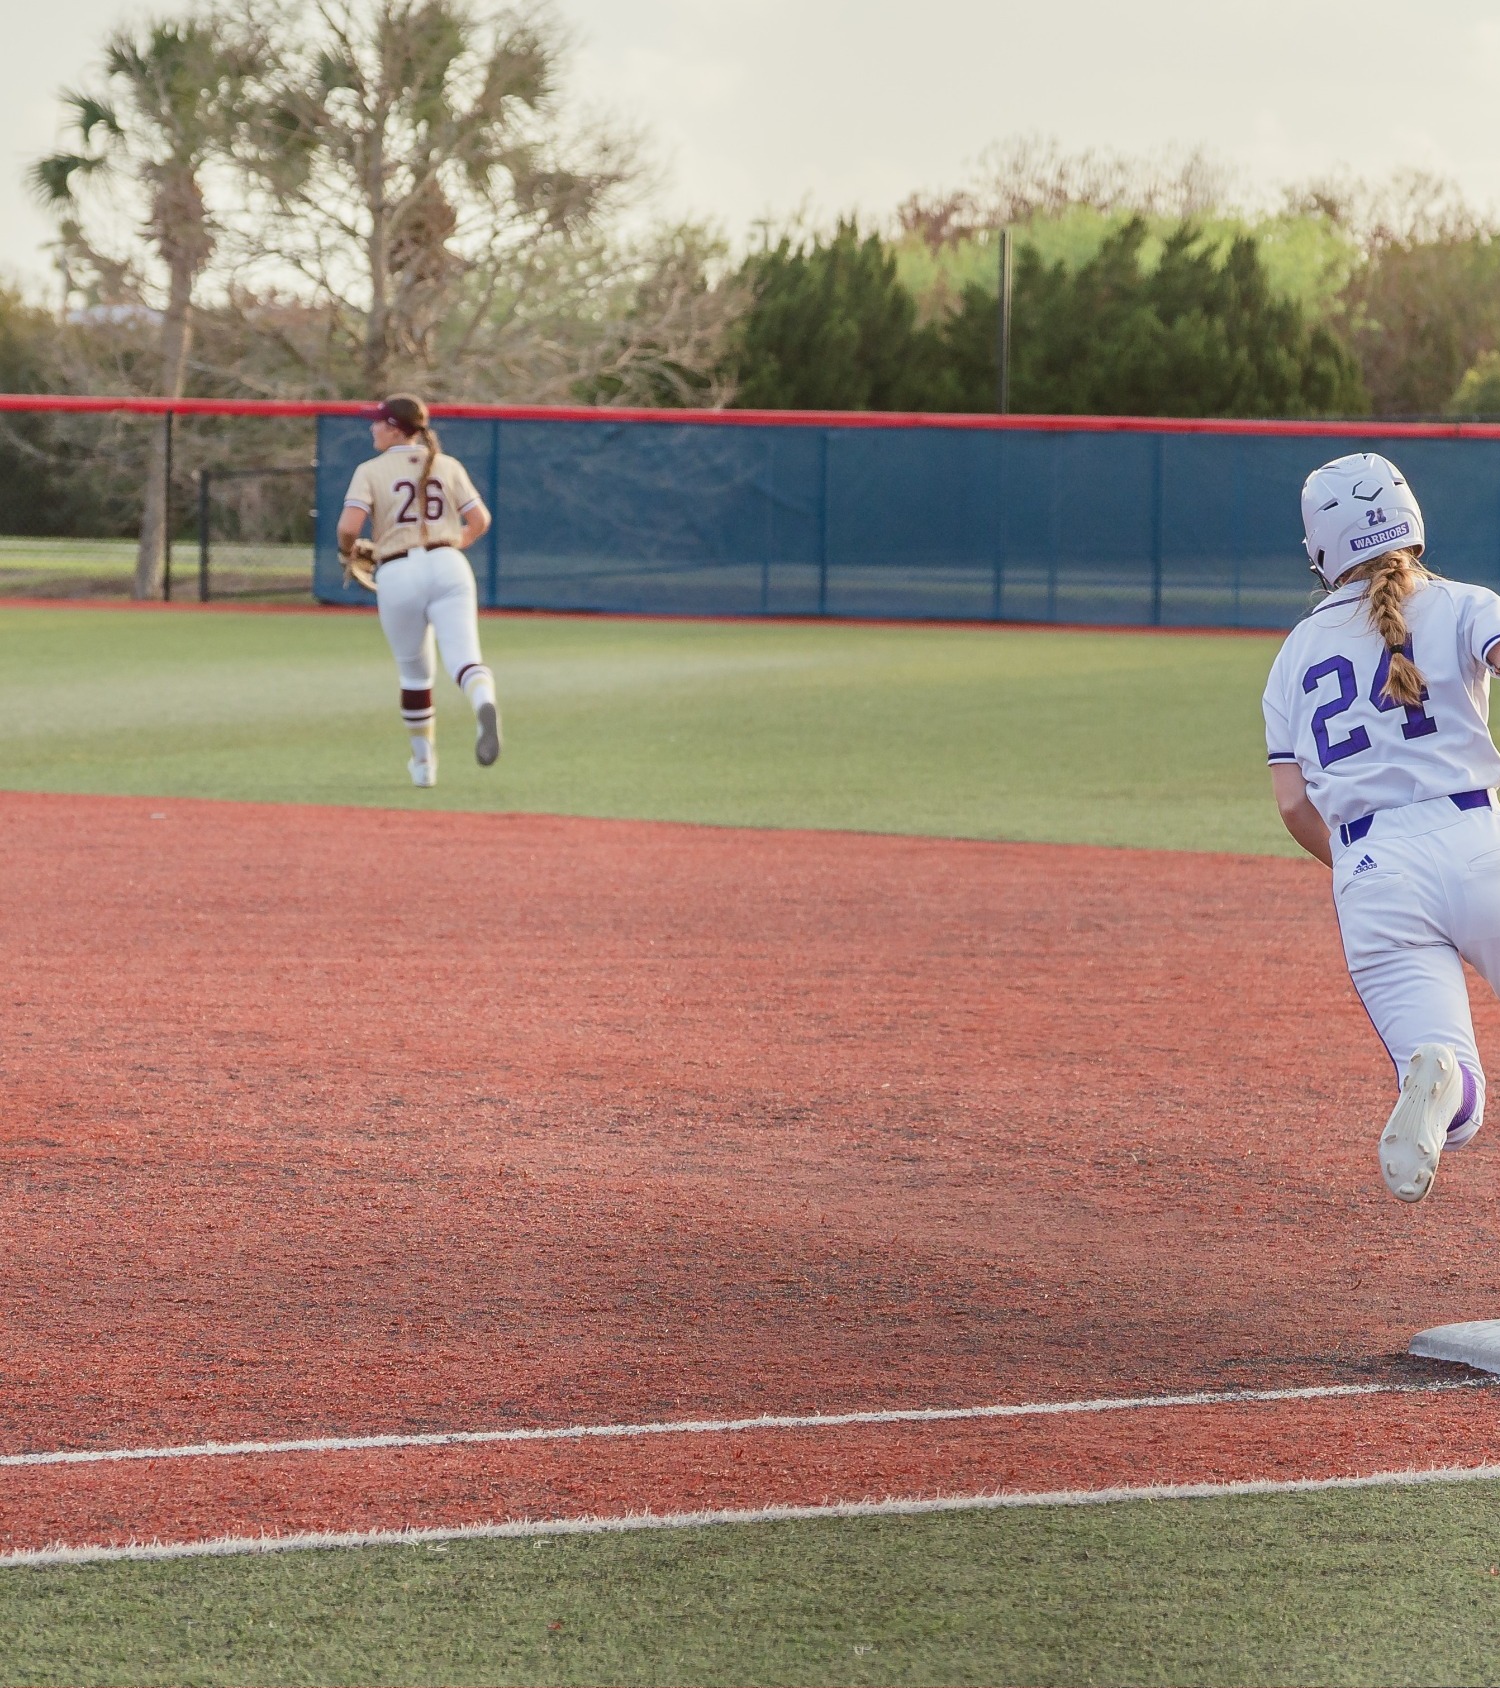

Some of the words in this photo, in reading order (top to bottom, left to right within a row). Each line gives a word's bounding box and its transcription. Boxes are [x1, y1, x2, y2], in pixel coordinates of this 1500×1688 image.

[393, 479, 443, 523] 26
[1353, 524, 1407, 549] WARRIORS
[1302, 632, 1438, 770] 24
[1353, 863, 1377, 876] adidas
